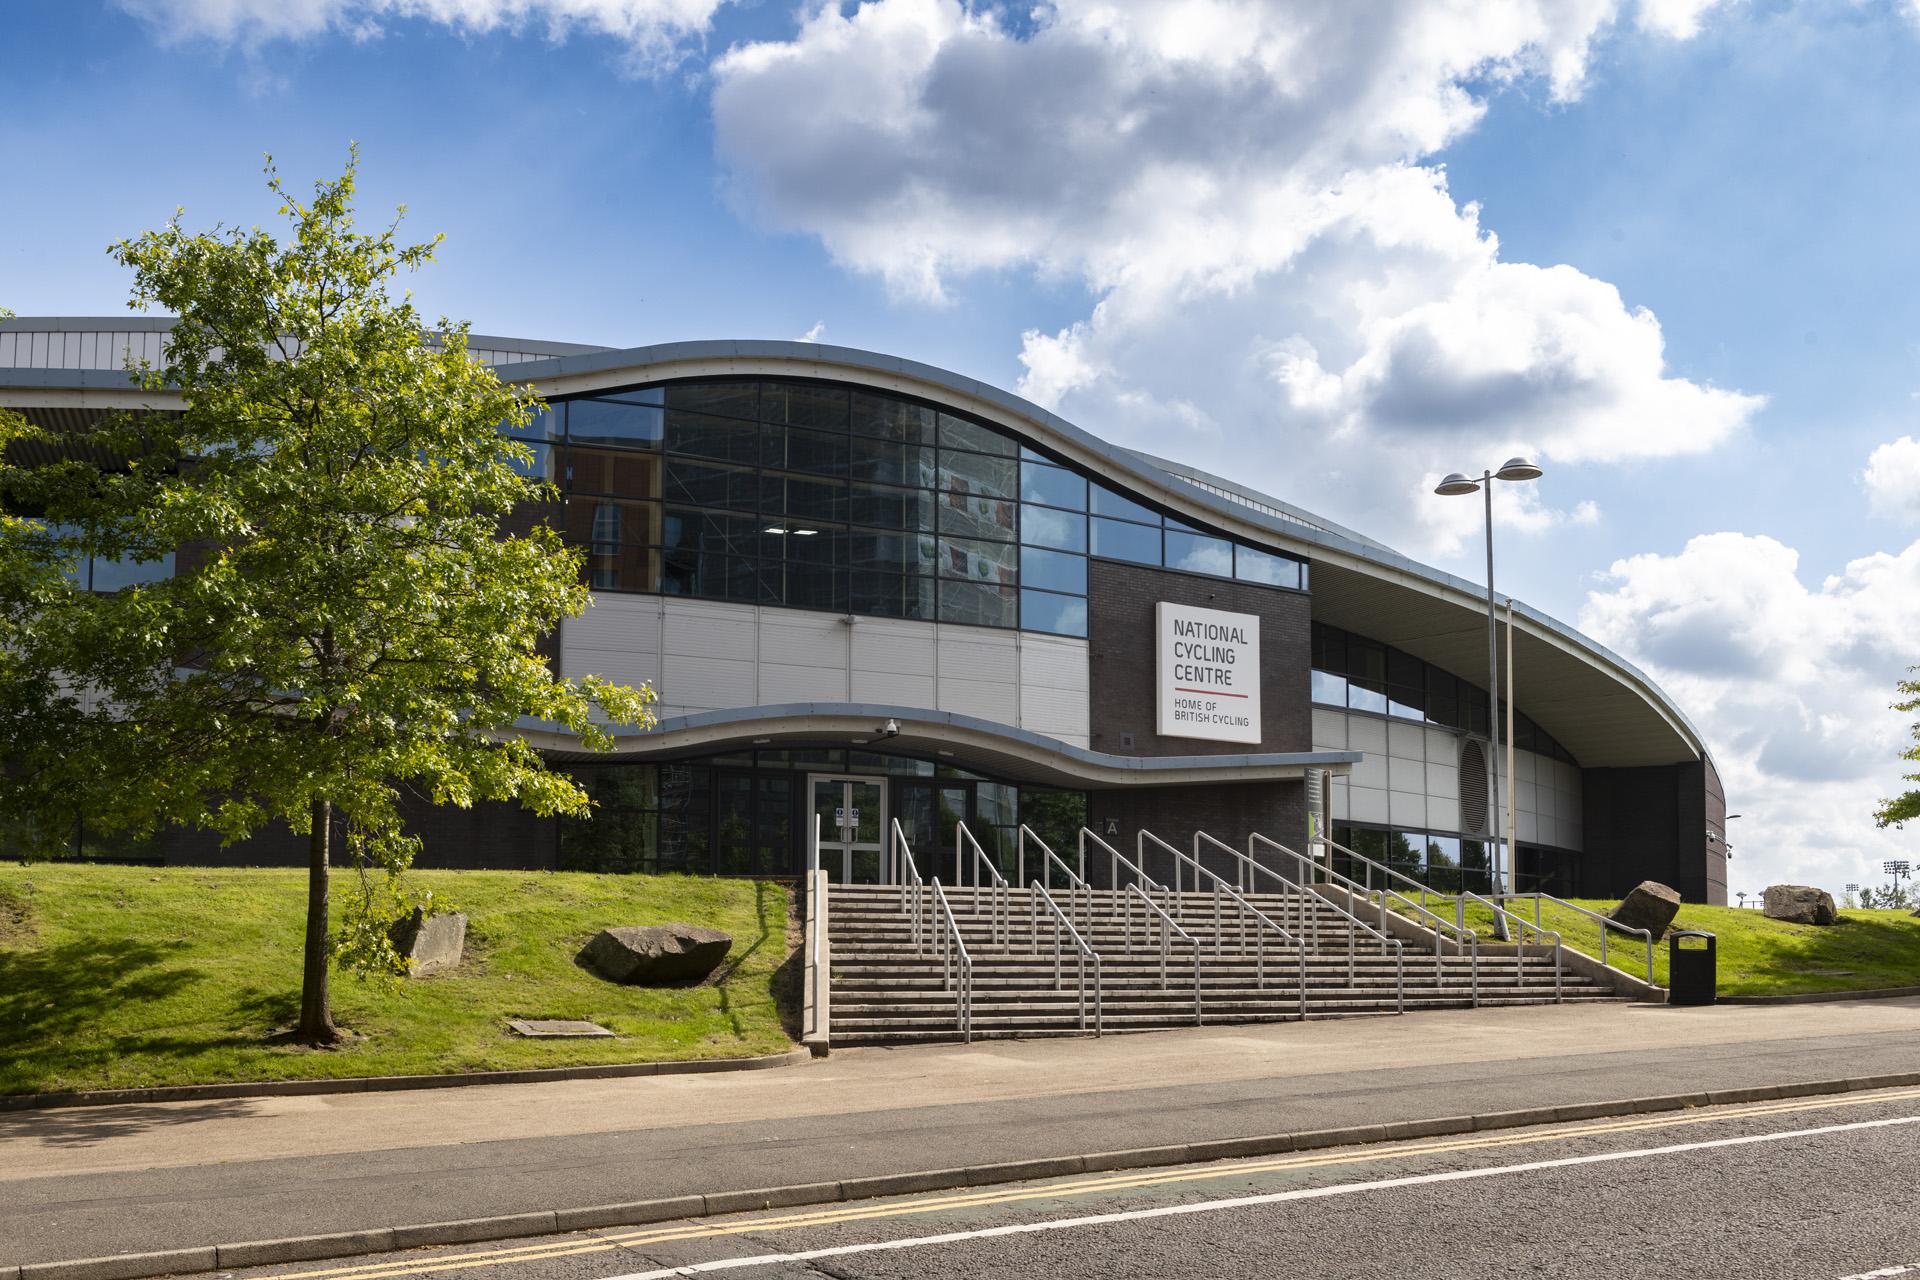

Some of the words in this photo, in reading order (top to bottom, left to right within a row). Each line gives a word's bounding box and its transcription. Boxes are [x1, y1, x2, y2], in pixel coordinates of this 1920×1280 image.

[1174, 618, 1249, 645] NATIONAL
[1174, 641, 1236, 665] CYCLING
[1174, 663, 1233, 686] CENTRE
[1174, 698, 1202, 711] HOME
[1205, 701, 1217, 712] OF
[1174, 709, 1210, 723] BRITISH
[1212, 713, 1250, 727] CYCLING
[1107, 822, 1118, 835] A
